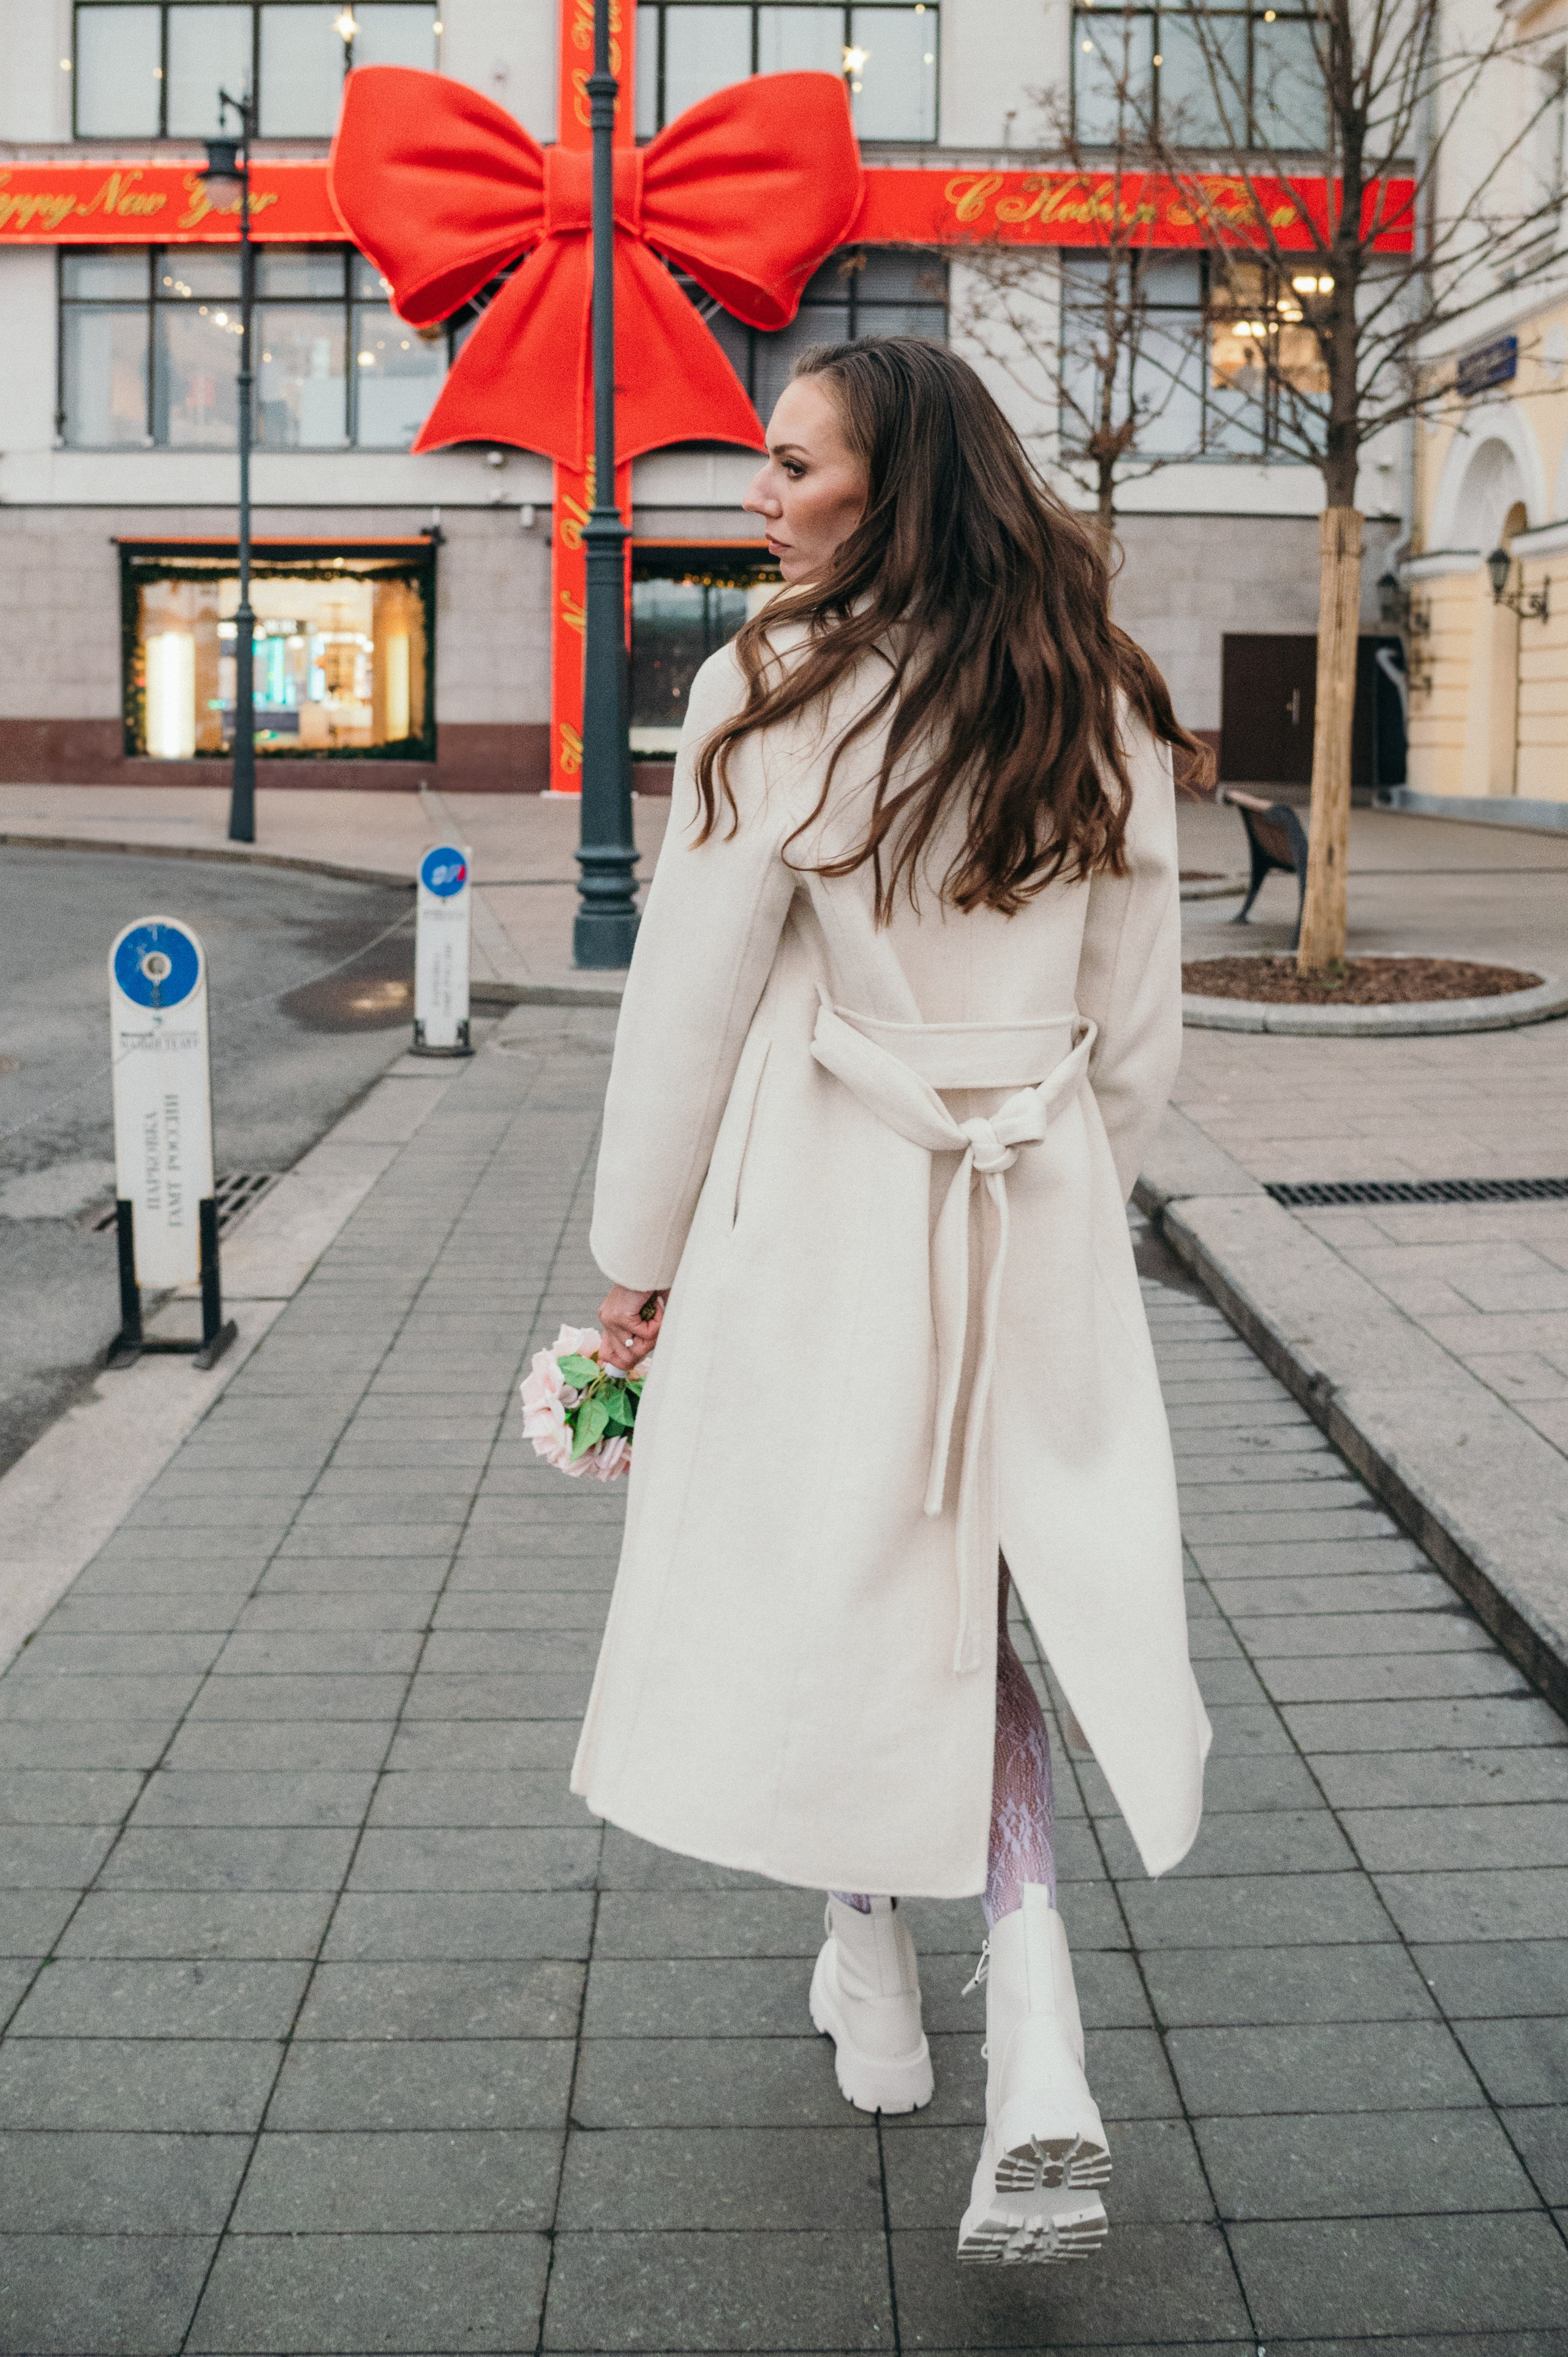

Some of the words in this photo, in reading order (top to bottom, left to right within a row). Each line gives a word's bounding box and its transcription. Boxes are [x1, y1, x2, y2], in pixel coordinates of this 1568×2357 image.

[76, 169, 167, 216] New
[177, 172, 278, 229] Yar
[944, 173, 1004, 222] С
[1166, 177, 1297, 228] Годм
